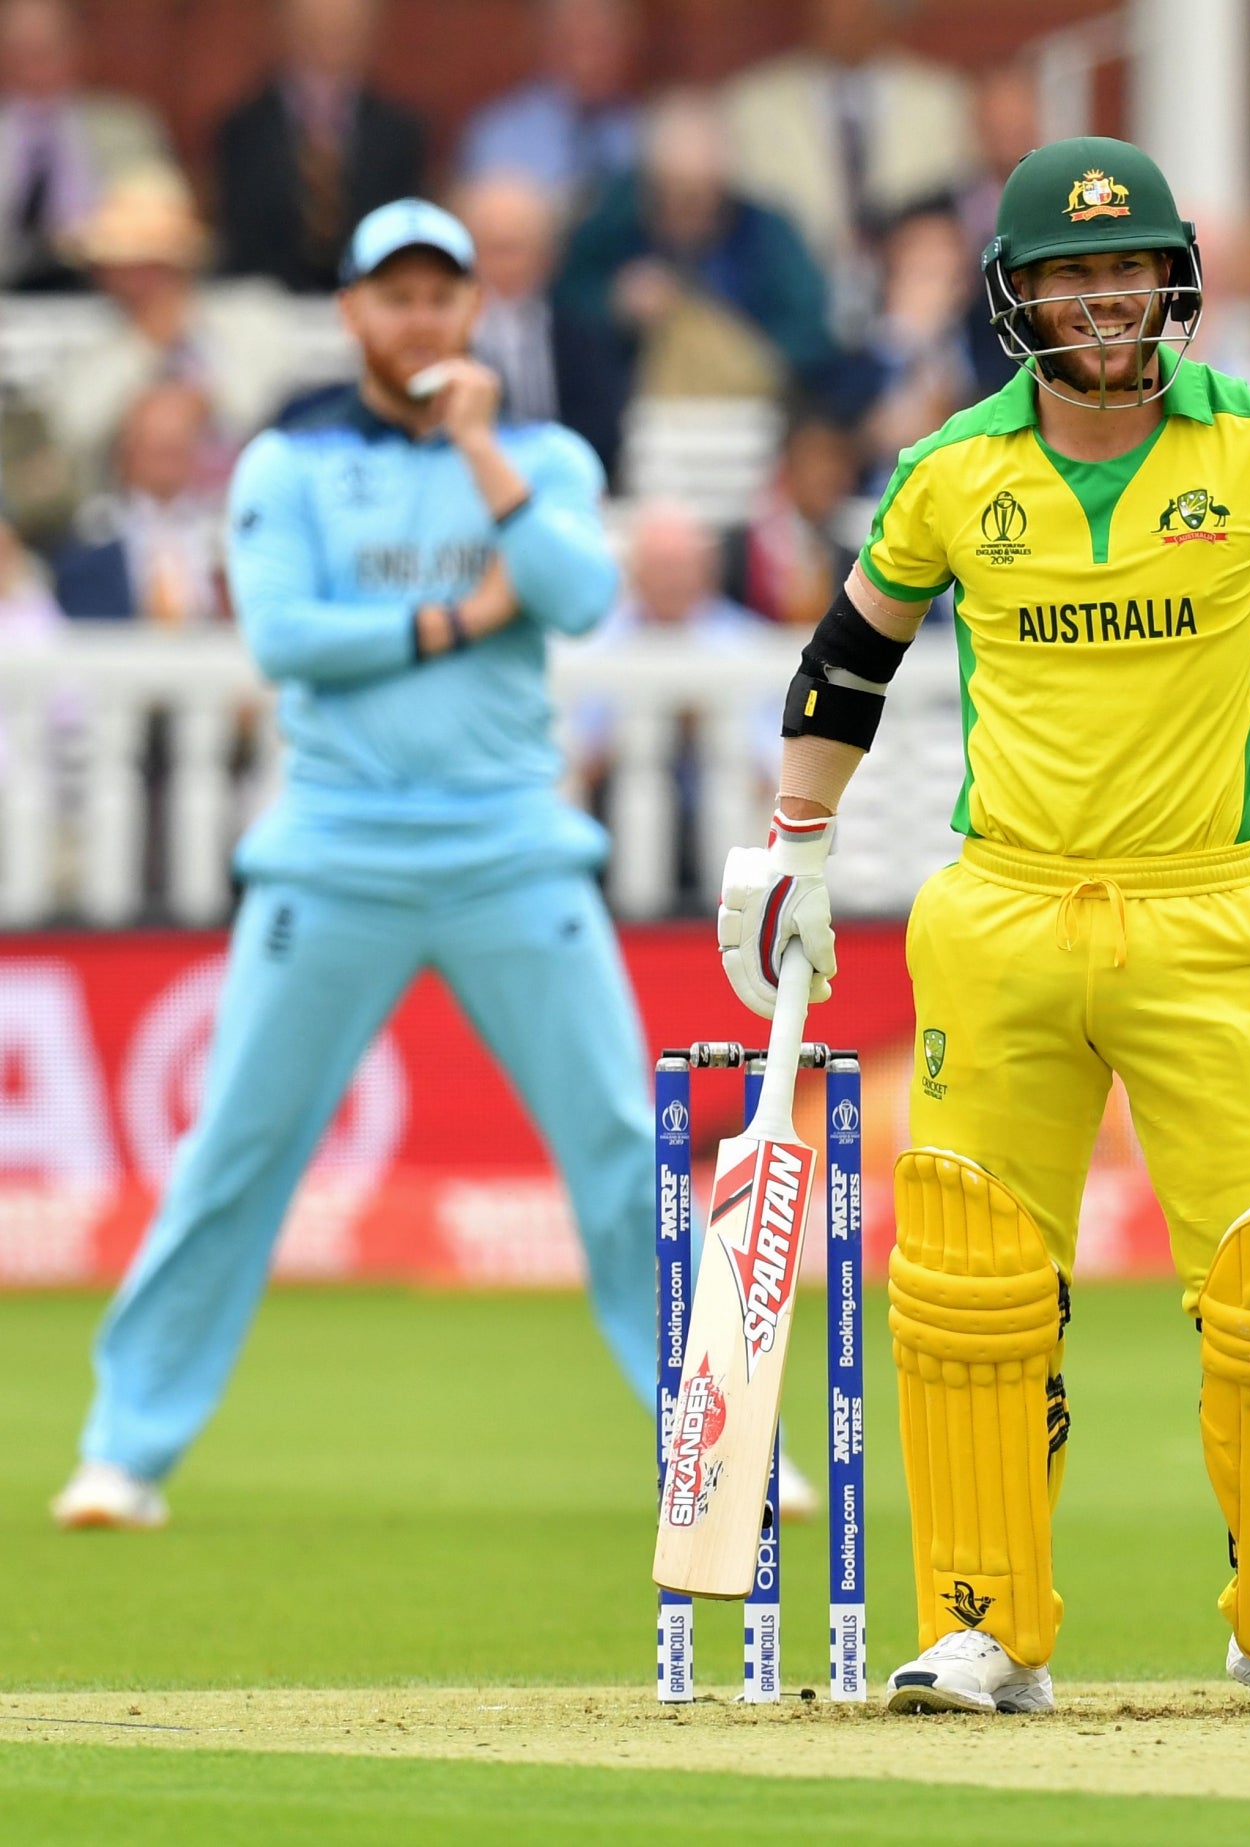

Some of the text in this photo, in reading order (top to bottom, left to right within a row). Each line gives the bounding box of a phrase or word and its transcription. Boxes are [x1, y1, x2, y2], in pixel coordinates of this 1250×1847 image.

[991, 556, 1014, 565] 2019
[1019, 598, 1197, 643] AUSTRALIA
[661, 1164, 677, 1241] MRF
[680, 1174, 690, 1231] TYRES
[831, 1163, 848, 1241] MRF
[850, 1173, 860, 1231] TYRES
[743, 1143, 803, 1353] SPARTAN
[668, 1261, 685, 1368] Booking.com
[839, 1260, 856, 1368] Booking.com
[669, 1376, 713, 1527] SIKANDER
[833, 1387, 849, 1465] MRF
[852, 1397, 862, 1455] TYRES
[841, 1484, 858, 1591] Booking.com
[671, 1615, 685, 1693] GRAY-NICOLLS
[761, 1614, 775, 1692] GRAY-NICOLLS
[843, 1615, 857, 1693] GRAY-NICOLLS
